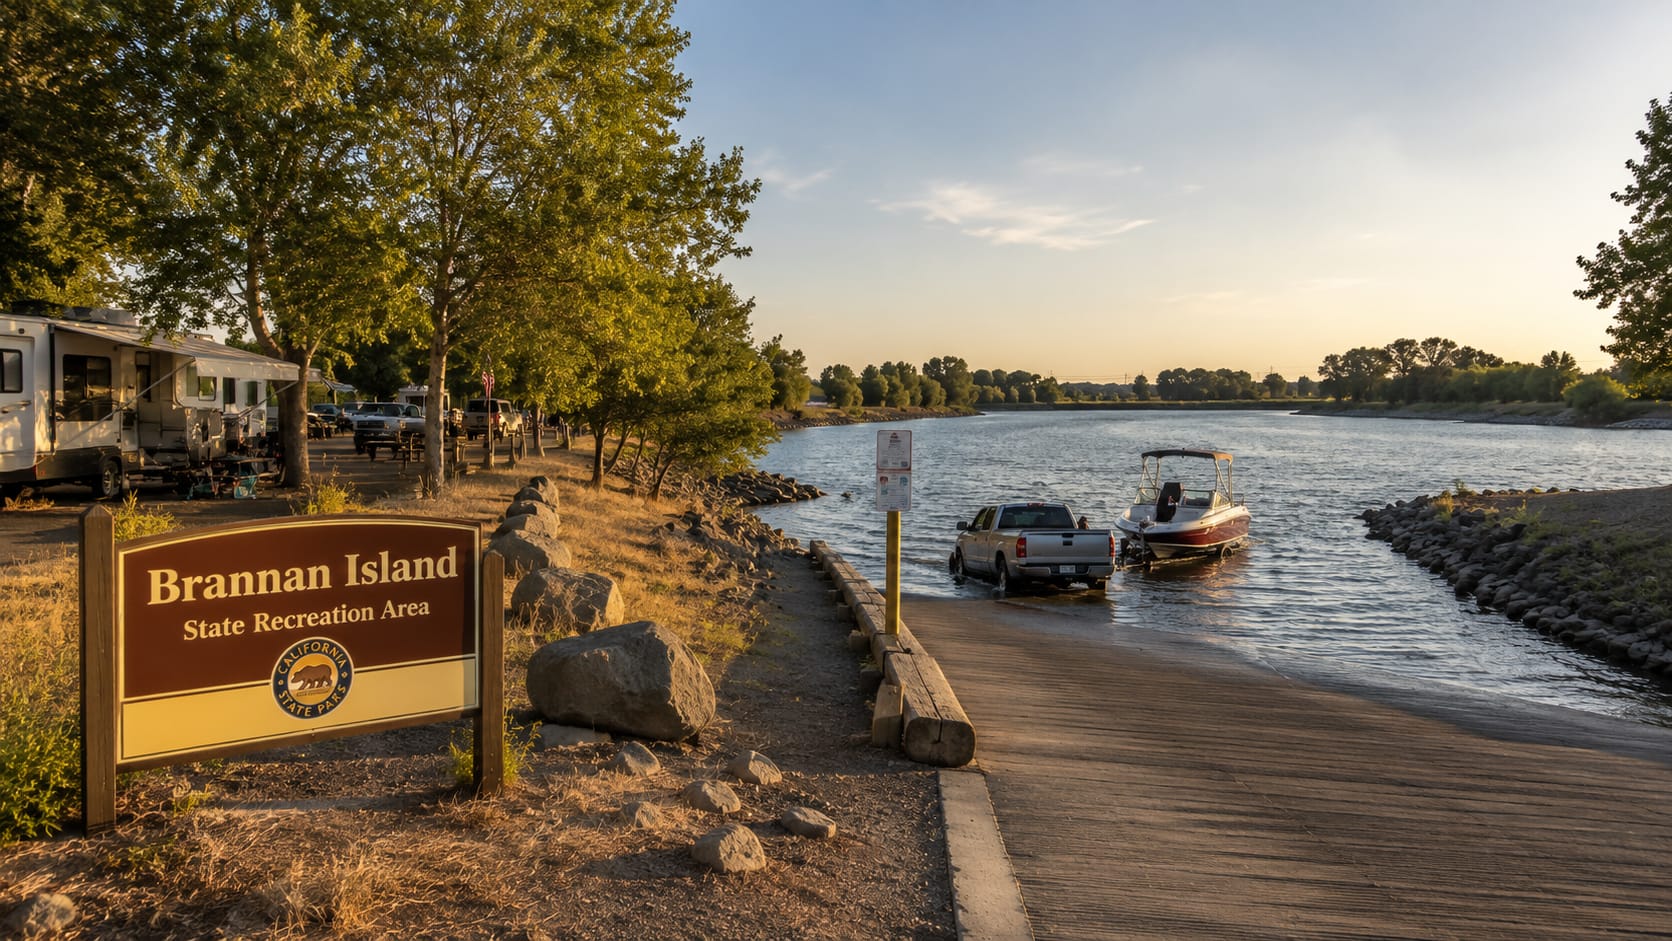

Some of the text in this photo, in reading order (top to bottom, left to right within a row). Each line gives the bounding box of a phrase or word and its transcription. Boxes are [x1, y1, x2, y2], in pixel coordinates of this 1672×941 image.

[147, 546, 458, 605] Brannan Island
[184, 600, 430, 641] State Recreation Area
[278, 641, 347, 674] CALIFORNIA
[279, 690, 312, 717] STATE
